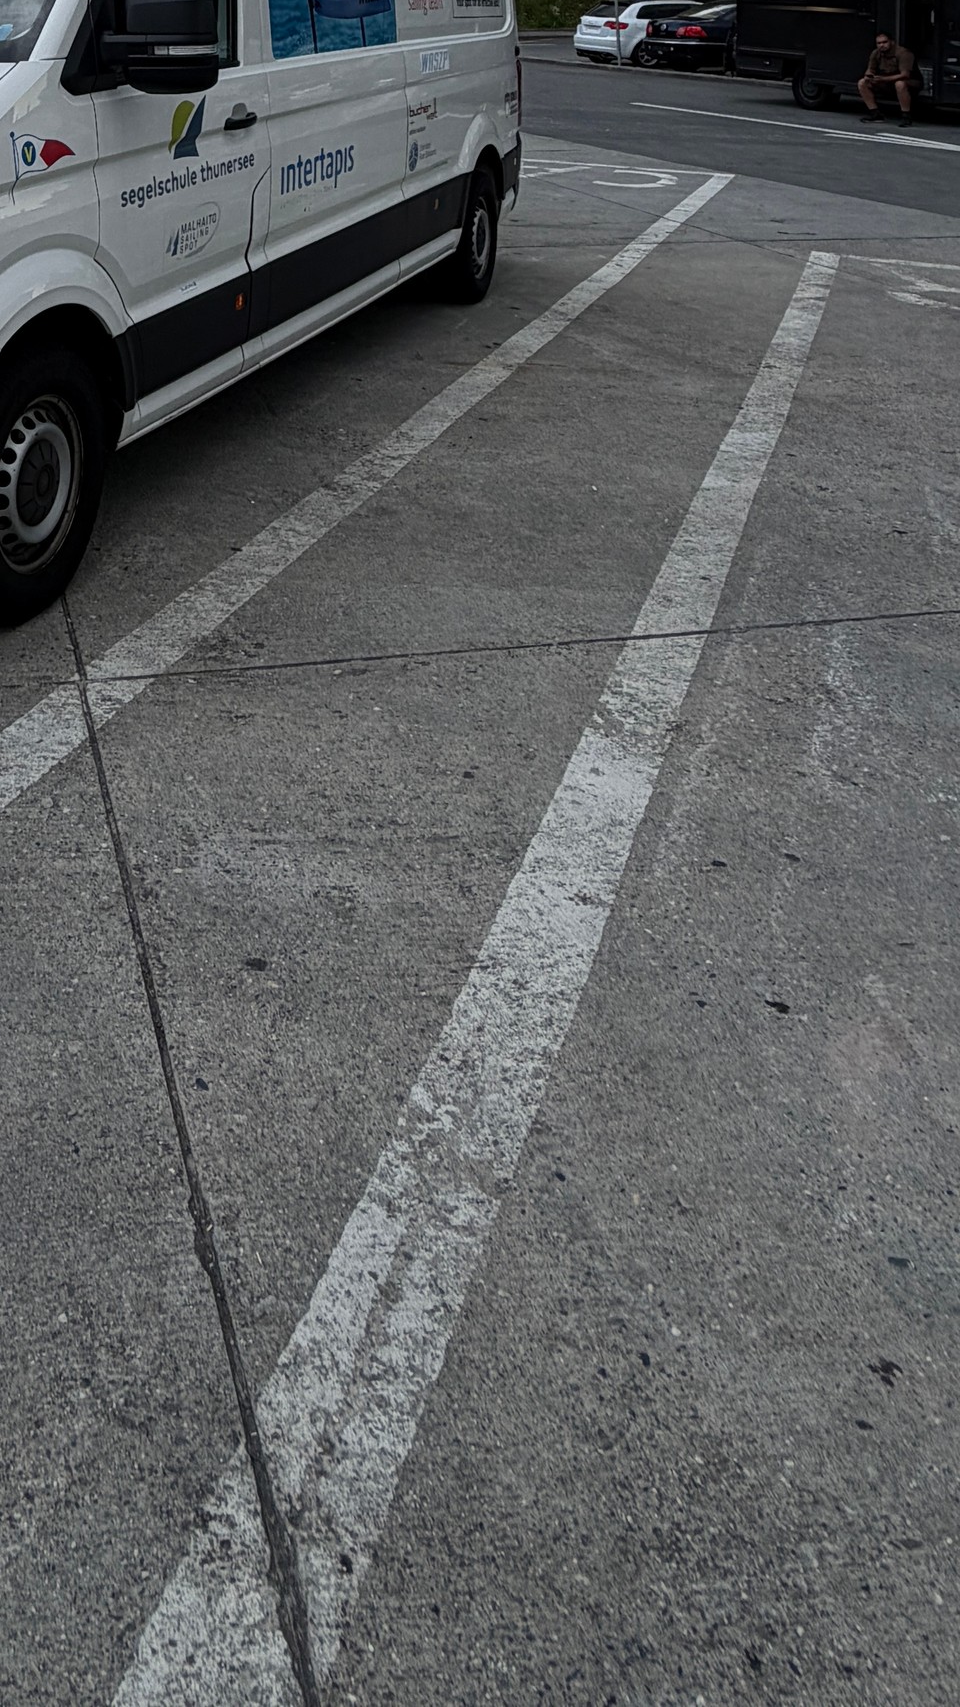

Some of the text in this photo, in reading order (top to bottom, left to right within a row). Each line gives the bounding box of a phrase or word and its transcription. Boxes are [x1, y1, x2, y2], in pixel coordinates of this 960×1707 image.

[421, 51, 448, 72] WASZP
[120, 153, 255, 208] segelschule thunersee
[180, 226, 209, 244] SAILING
[179, 239, 198, 254] SPOT
